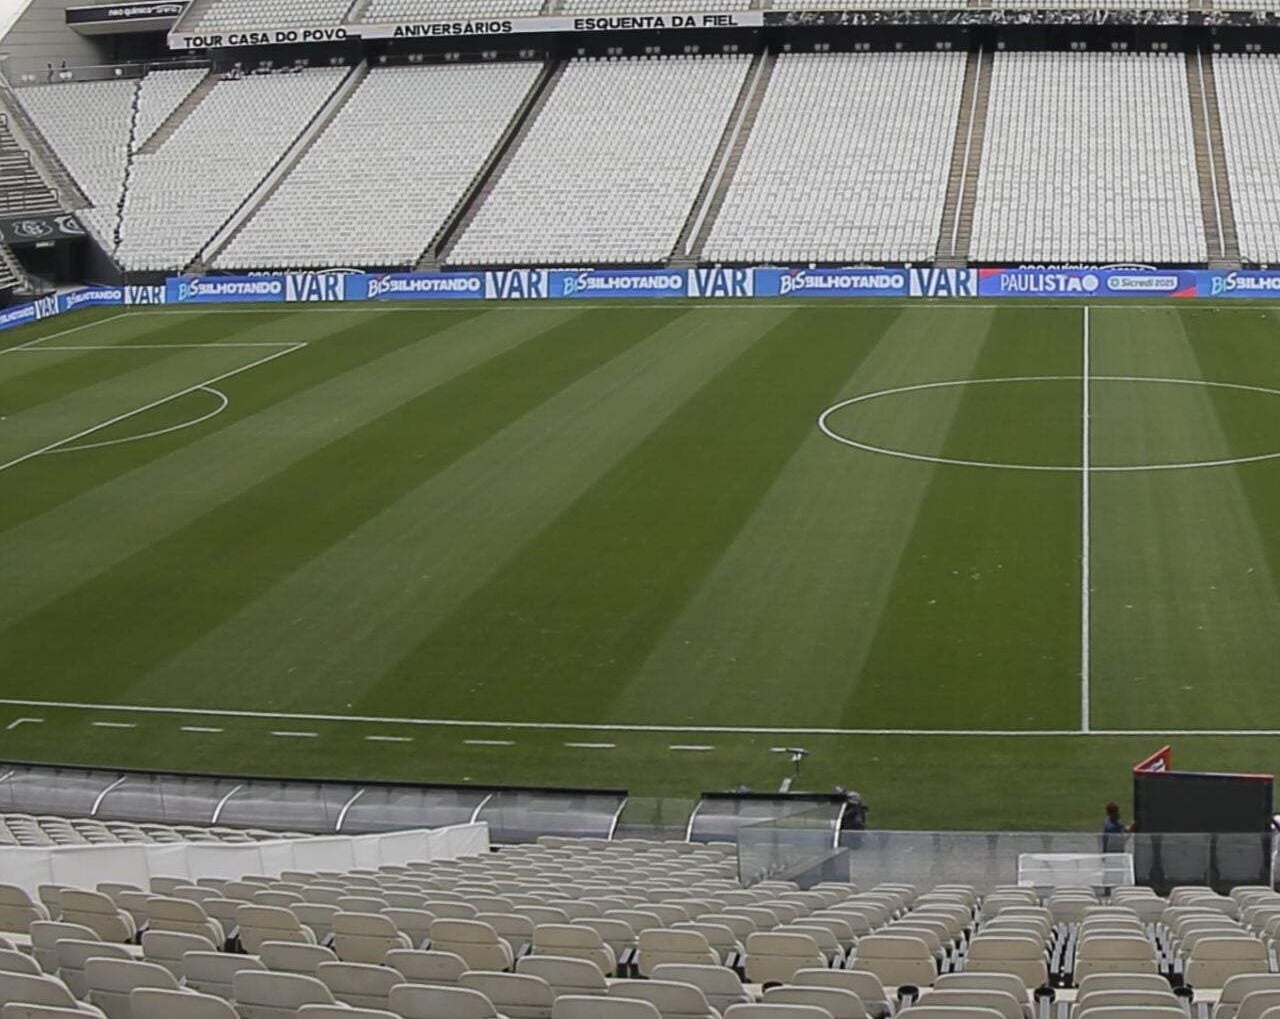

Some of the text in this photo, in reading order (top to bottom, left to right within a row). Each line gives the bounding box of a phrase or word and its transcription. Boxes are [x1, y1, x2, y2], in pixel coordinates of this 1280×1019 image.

[573, 15, 738, 30] ESQUENTA DA FIEL
[184, 28, 347, 48] TOUR CASA DO POVO
[287, 273, 342, 301] VAR
[487, 271, 546, 298] VAR
[690, 268, 751, 297] VAR
[911, 268, 976, 296] VAR
[35, 296, 58, 319] VAR
[125, 286, 166, 304] VAR
